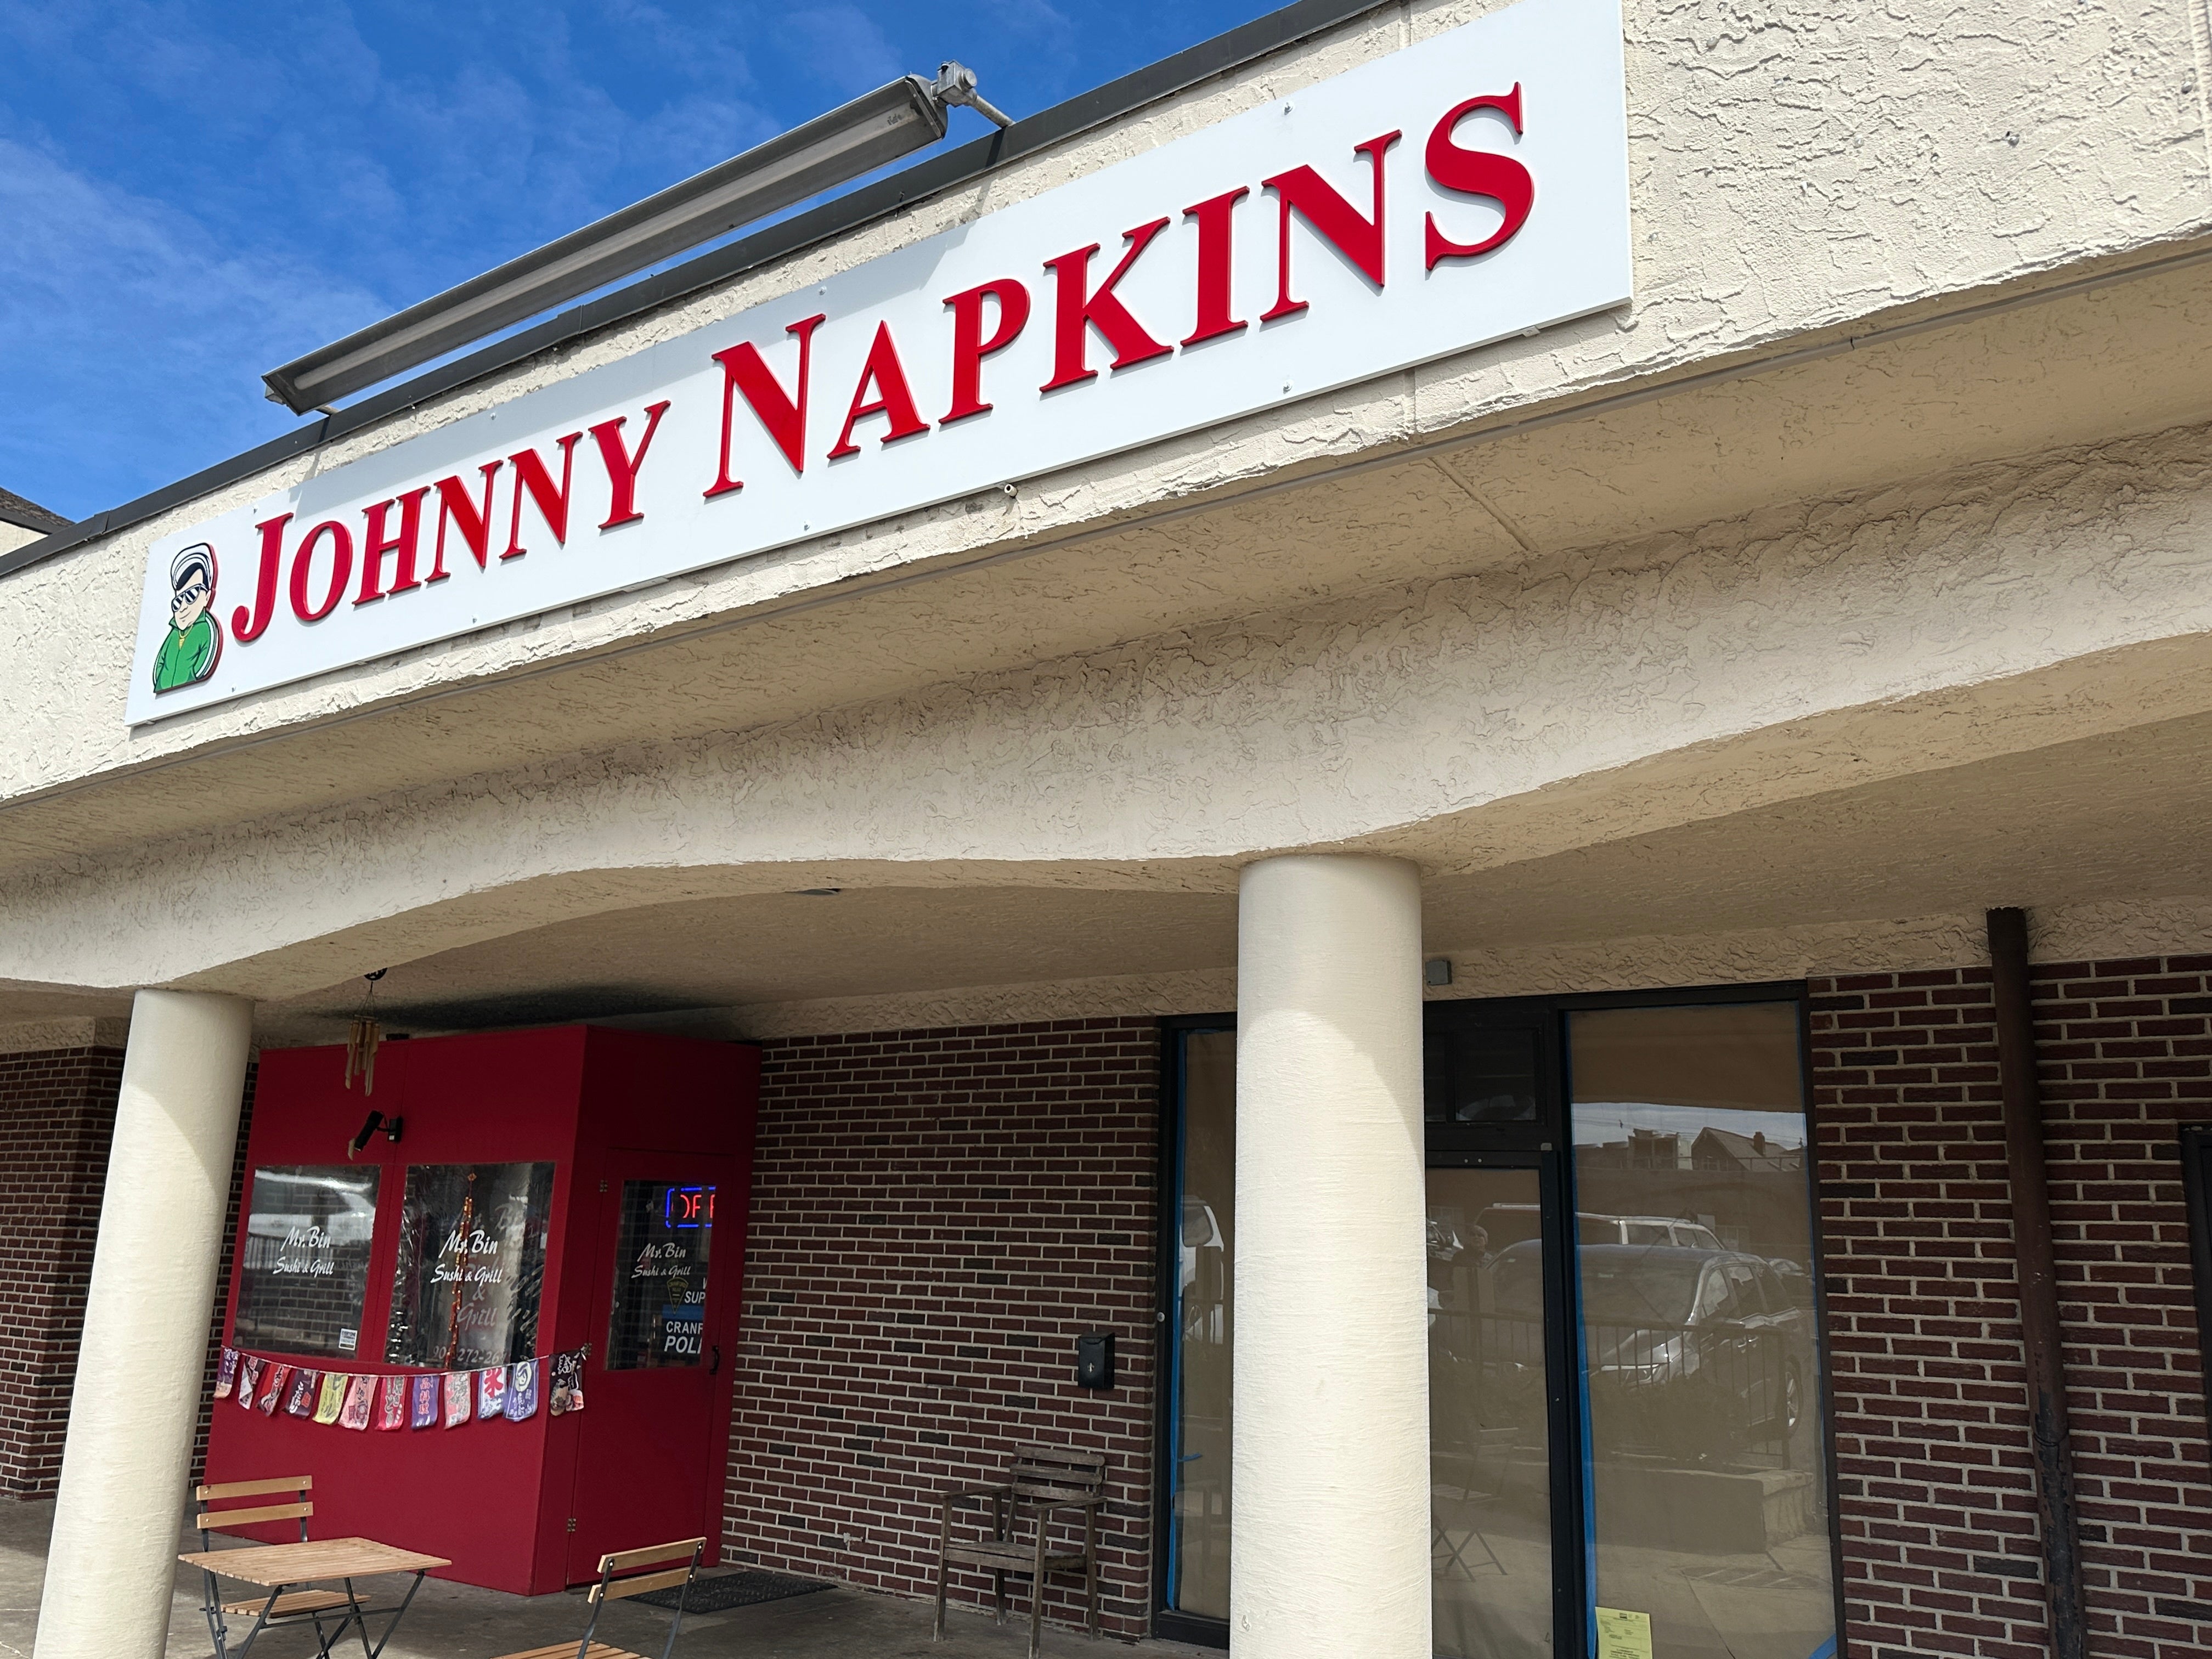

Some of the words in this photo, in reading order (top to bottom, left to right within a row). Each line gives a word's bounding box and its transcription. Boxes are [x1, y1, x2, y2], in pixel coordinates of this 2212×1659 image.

[231, 399, 672, 643] JOHNNY
[702, 81, 1536, 499] NAPKINS
[280, 1226, 304, 1252] Mr.
[307, 1226, 331, 1248] Bin
[439, 1229, 467, 1258] Mr.
[469, 1229, 498, 1254] Bin
[637, 1243, 662, 1262] Mr.
[663, 1242, 686, 1258] Bin
[273, 1256, 301, 1274] Sushi
[310, 1259, 335, 1278] Grill
[430, 1263, 463, 1283] Sushi
[466, 1271, 472, 1282] &
[474, 1266, 503, 1286] Grill
[631, 1265, 659, 1278] Sushi
[668, 1265, 691, 1279] Grill
[472, 1286, 486, 1301] &
[457, 1302, 497, 1330] Grill
